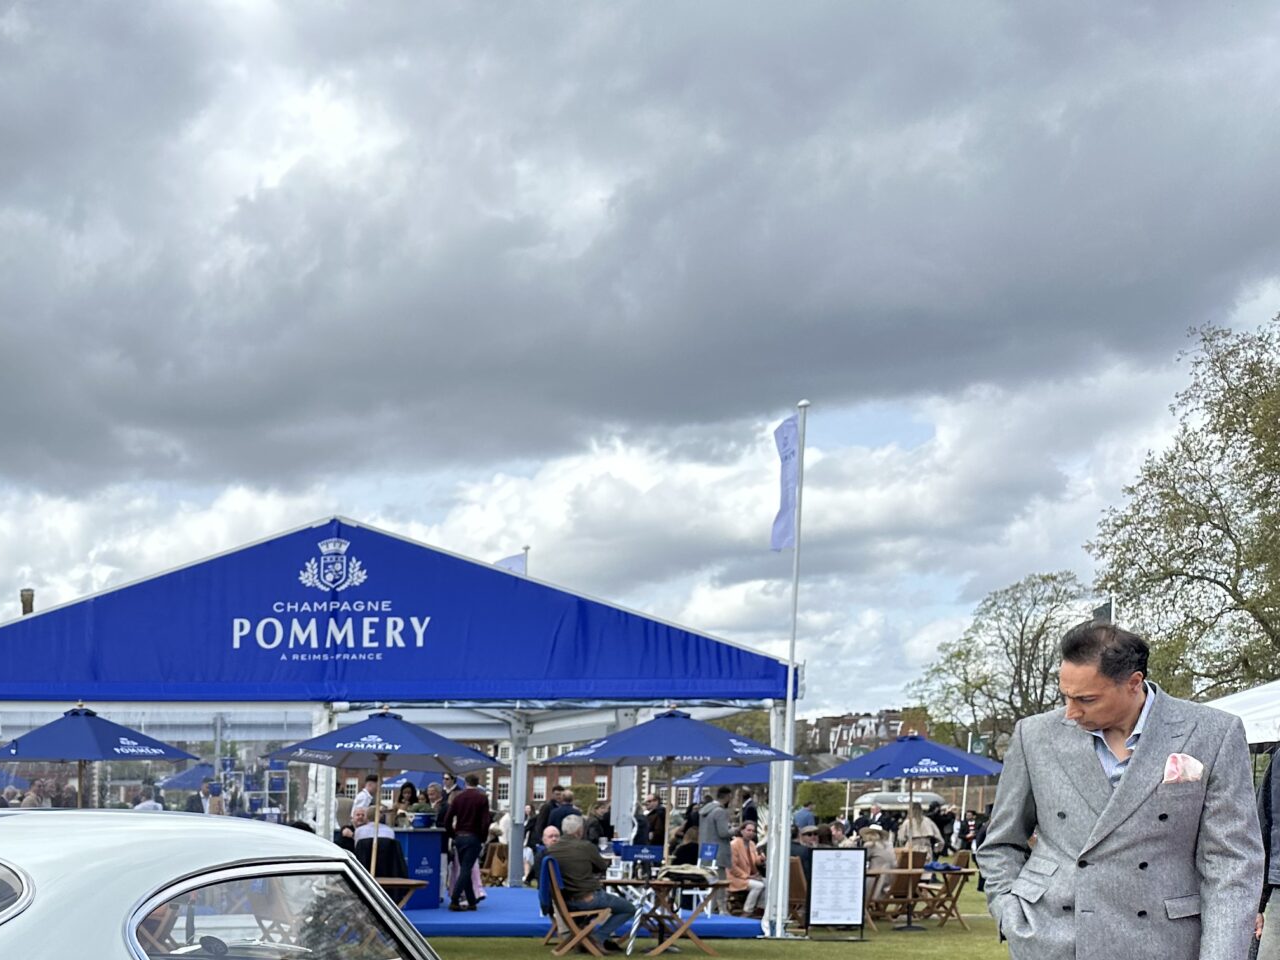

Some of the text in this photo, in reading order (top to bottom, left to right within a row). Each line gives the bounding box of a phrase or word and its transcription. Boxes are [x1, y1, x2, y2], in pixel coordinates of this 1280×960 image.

[273, 600, 392, 613] CHAMPAGNE
[232, 616, 432, 650] POMMERY
[335, 742, 402, 751] POMMERY
[903, 766, 959, 774] POMMERY
